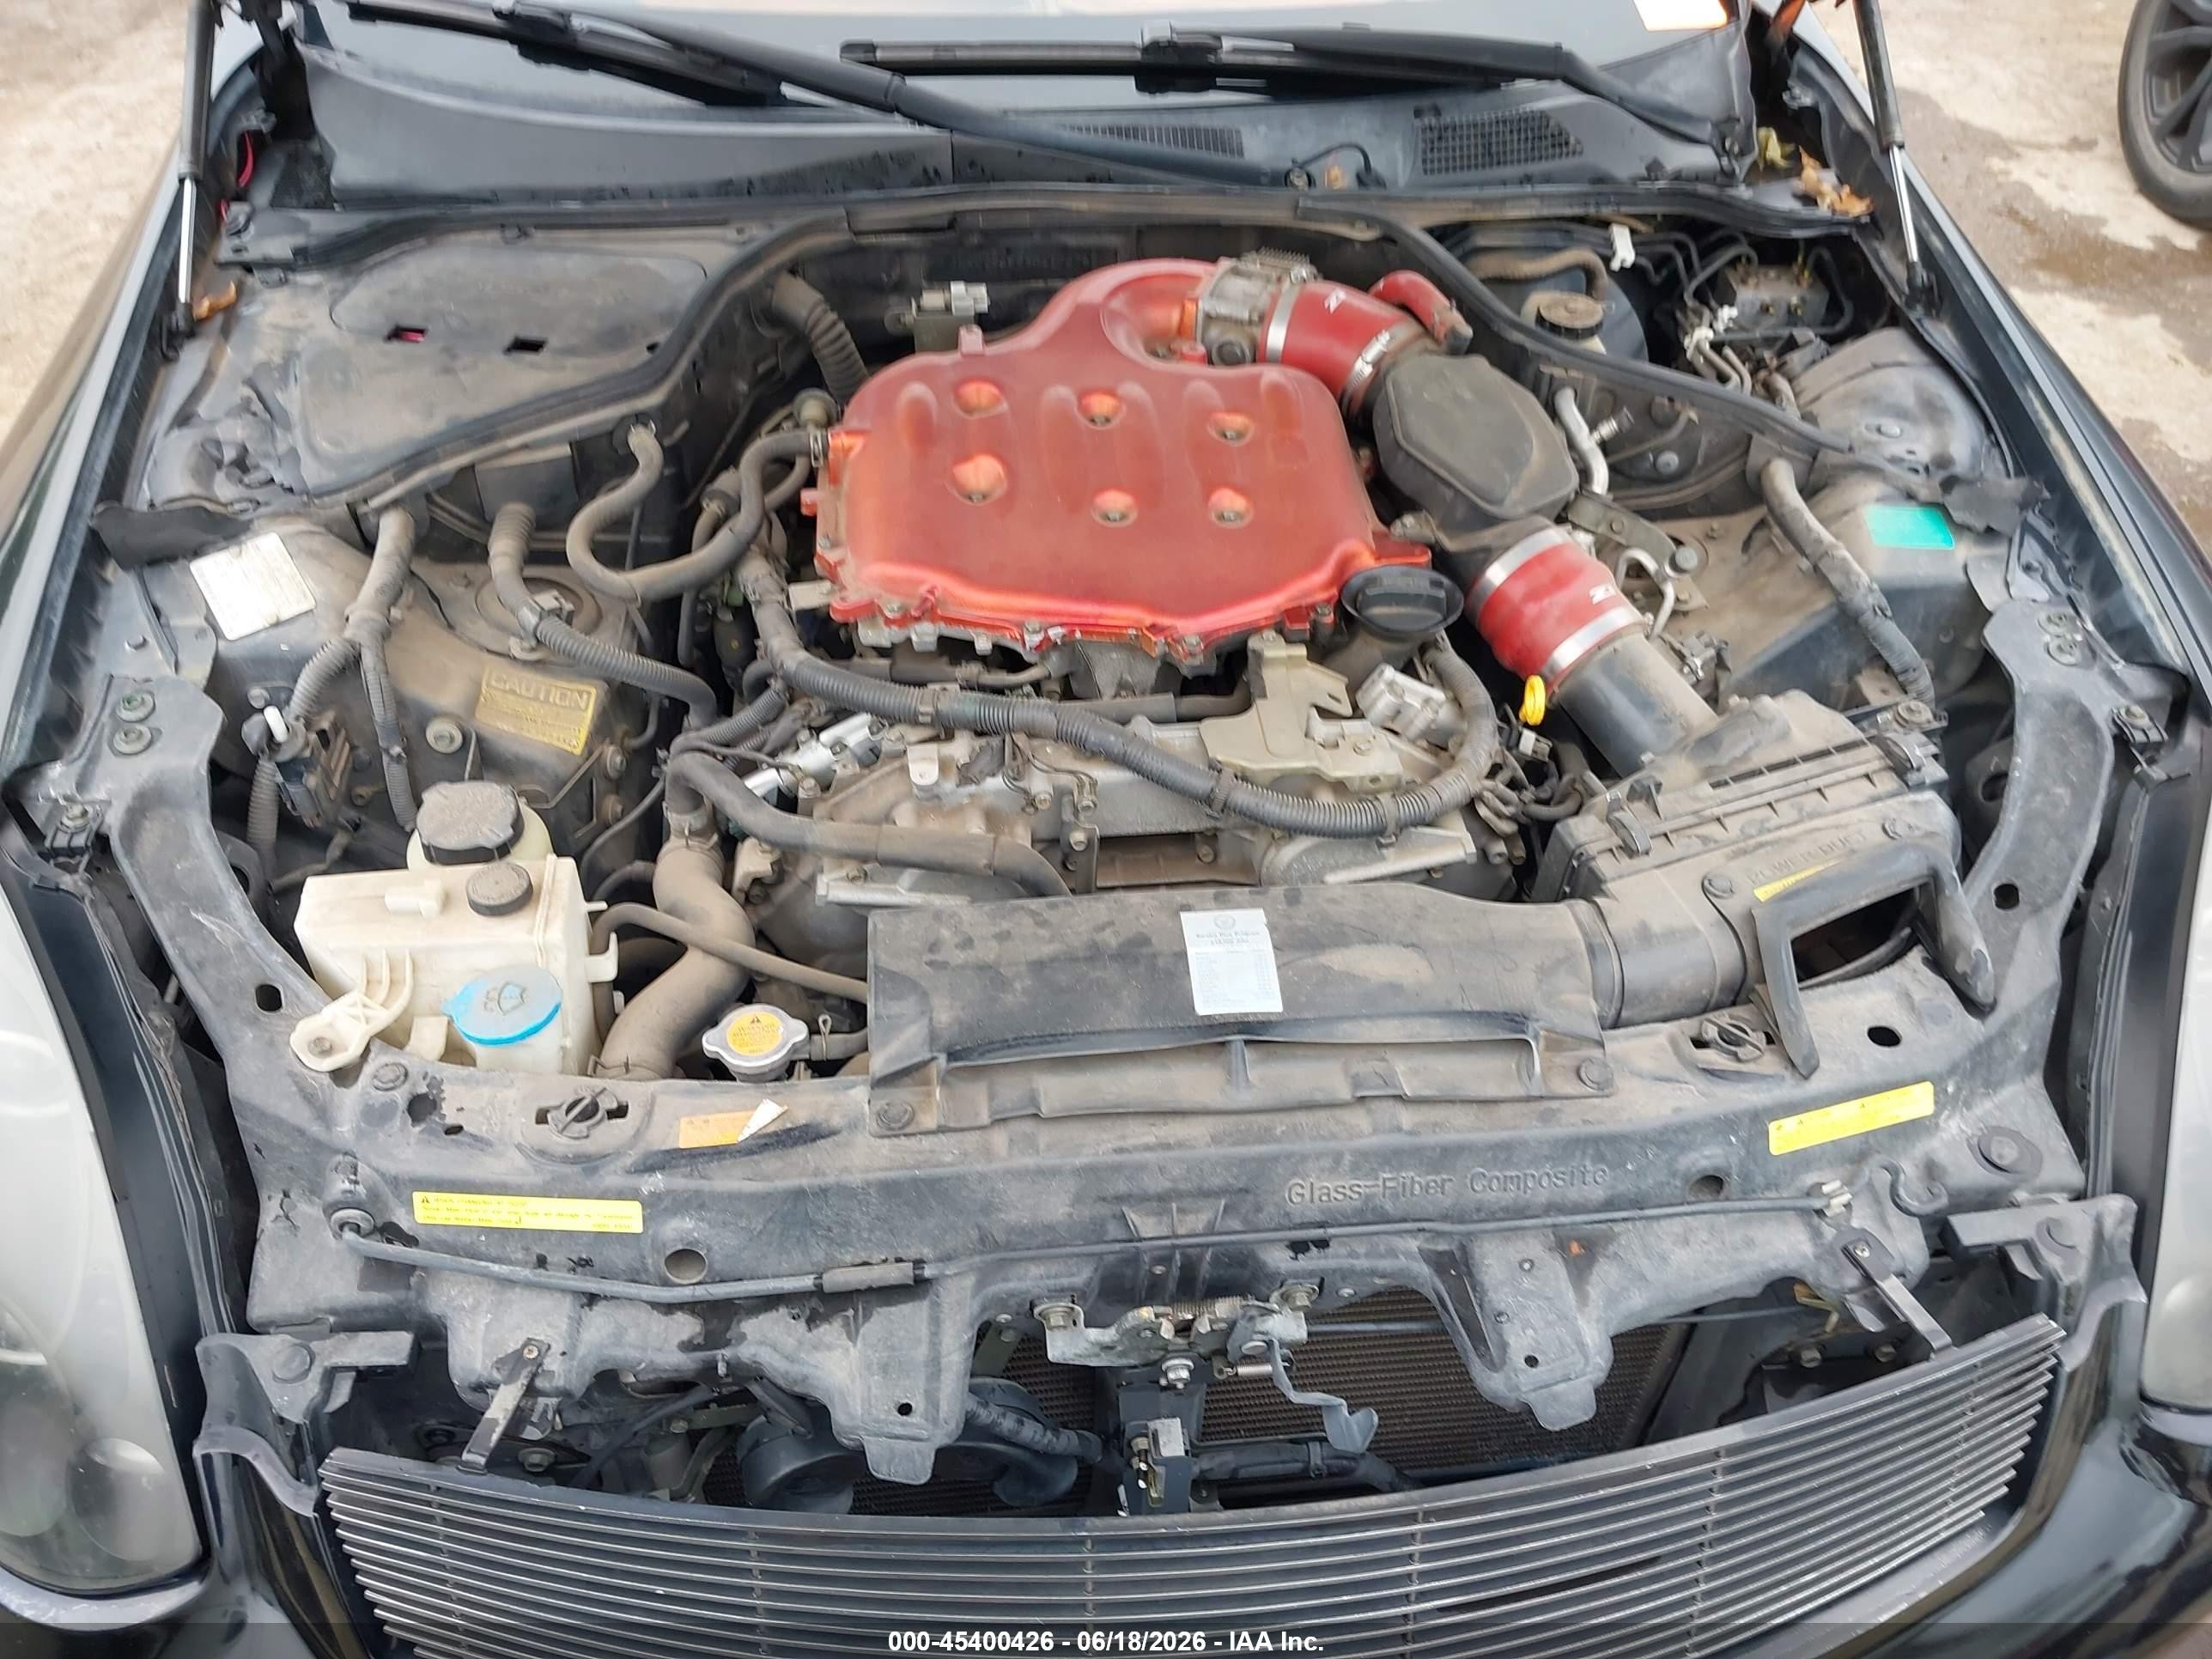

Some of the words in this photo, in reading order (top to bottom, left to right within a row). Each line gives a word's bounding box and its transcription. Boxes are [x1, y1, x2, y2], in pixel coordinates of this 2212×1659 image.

[489, 672, 589, 710] CAUTION
[1285, 1172, 1455, 1206] Glass-Fiber
[1469, 1164, 1609, 1195] Composite
